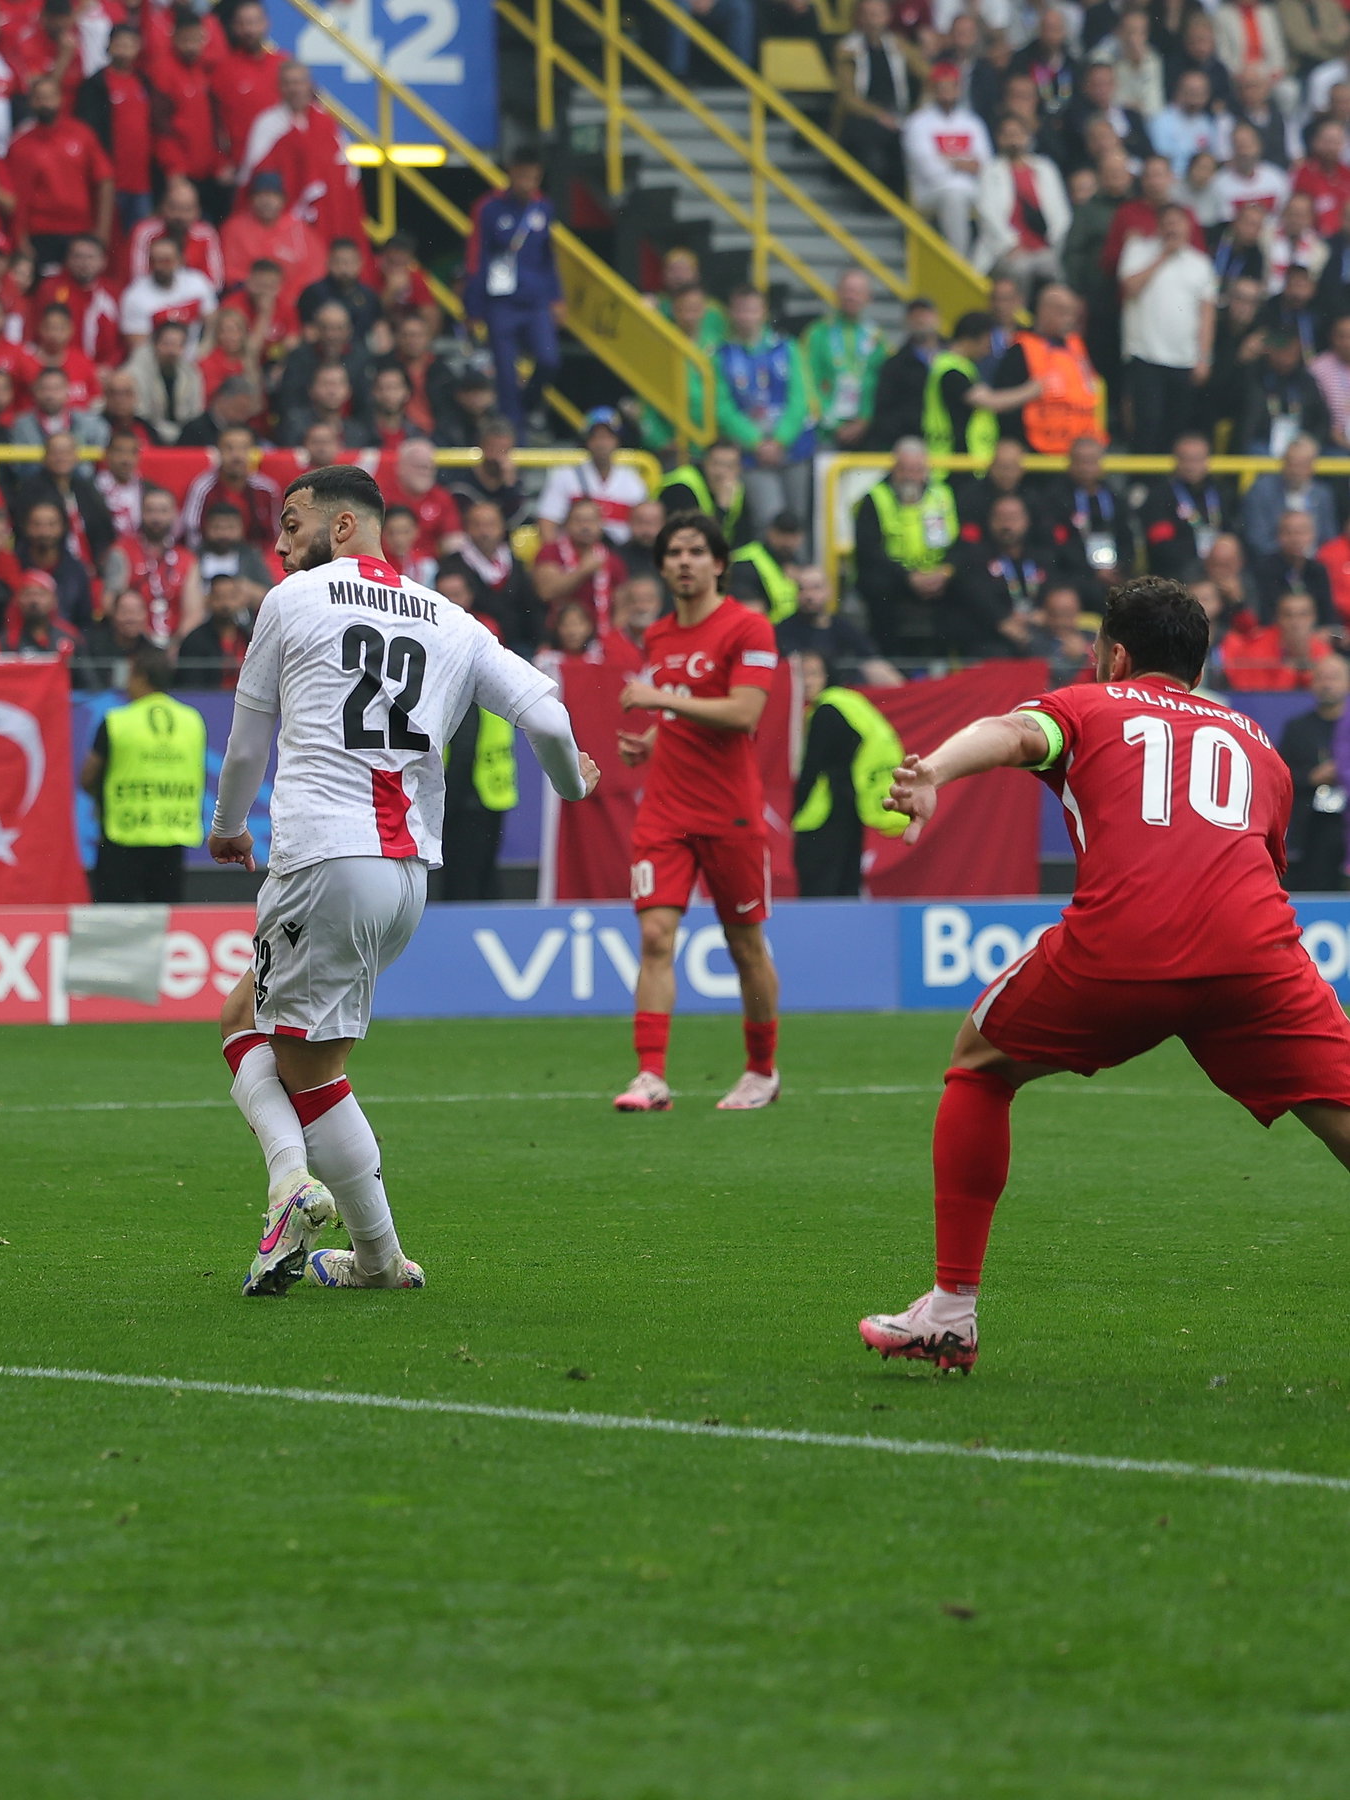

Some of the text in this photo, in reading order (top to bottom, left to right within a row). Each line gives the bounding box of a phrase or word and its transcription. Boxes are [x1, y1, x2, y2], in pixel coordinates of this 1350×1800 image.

[296, 0, 465, 84] 42
[328, 581, 439, 627] MIKAUTADZE
[341, 624, 431, 752] 22
[1105, 685, 1272, 750] ÇALHANOĞLU
[1123, 715, 1252, 831] 10
